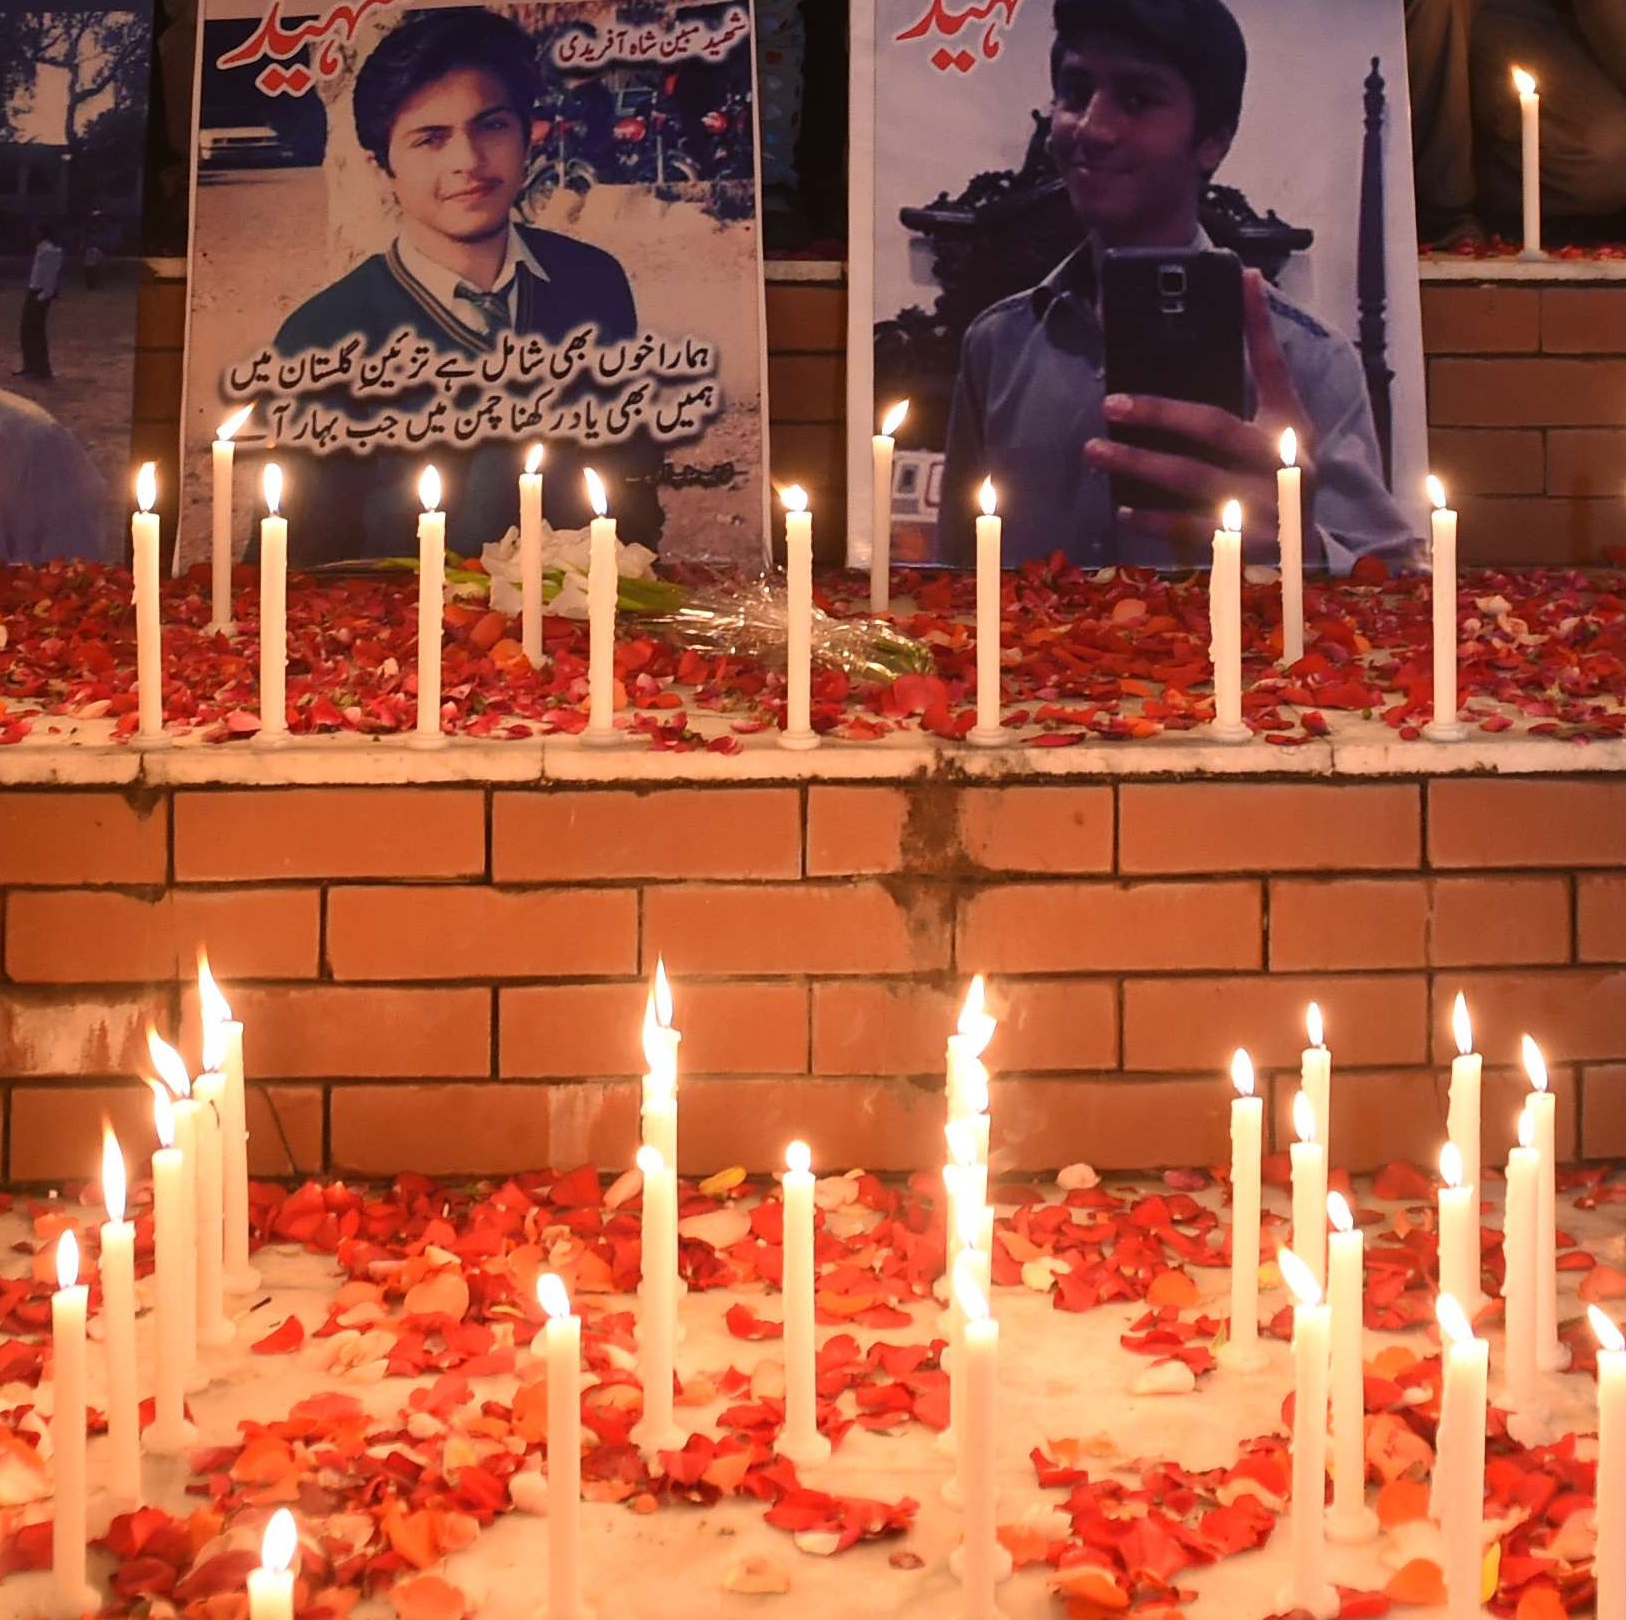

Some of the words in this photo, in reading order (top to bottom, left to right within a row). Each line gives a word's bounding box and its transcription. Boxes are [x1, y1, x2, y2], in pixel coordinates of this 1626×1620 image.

[559, 30, 628, 62] آفریدی
[629, 31, 657, 55] شاہ
[660, 25, 700, 57] مبین
[231, 351, 272, 391] میں
[278, 338, 360, 389] گلستان
[482, 335, 545, 383] شامل
[550, 328, 593, 380] بھی
[598, 334, 655, 378] خوں
[659, 339, 709, 369] ہمارا
[435, 357, 475, 392] ہے
[293, 409, 340, 448] بہار
[407, 401, 447, 442] میں
[454, 395, 503, 440] چمن
[511, 387, 563, 433] رکھنا
[570, 400, 600, 440] یاد
[606, 383, 650, 435] بھی
[656, 385, 714, 433] ہمیں
[346, 414, 399, 448] جب
